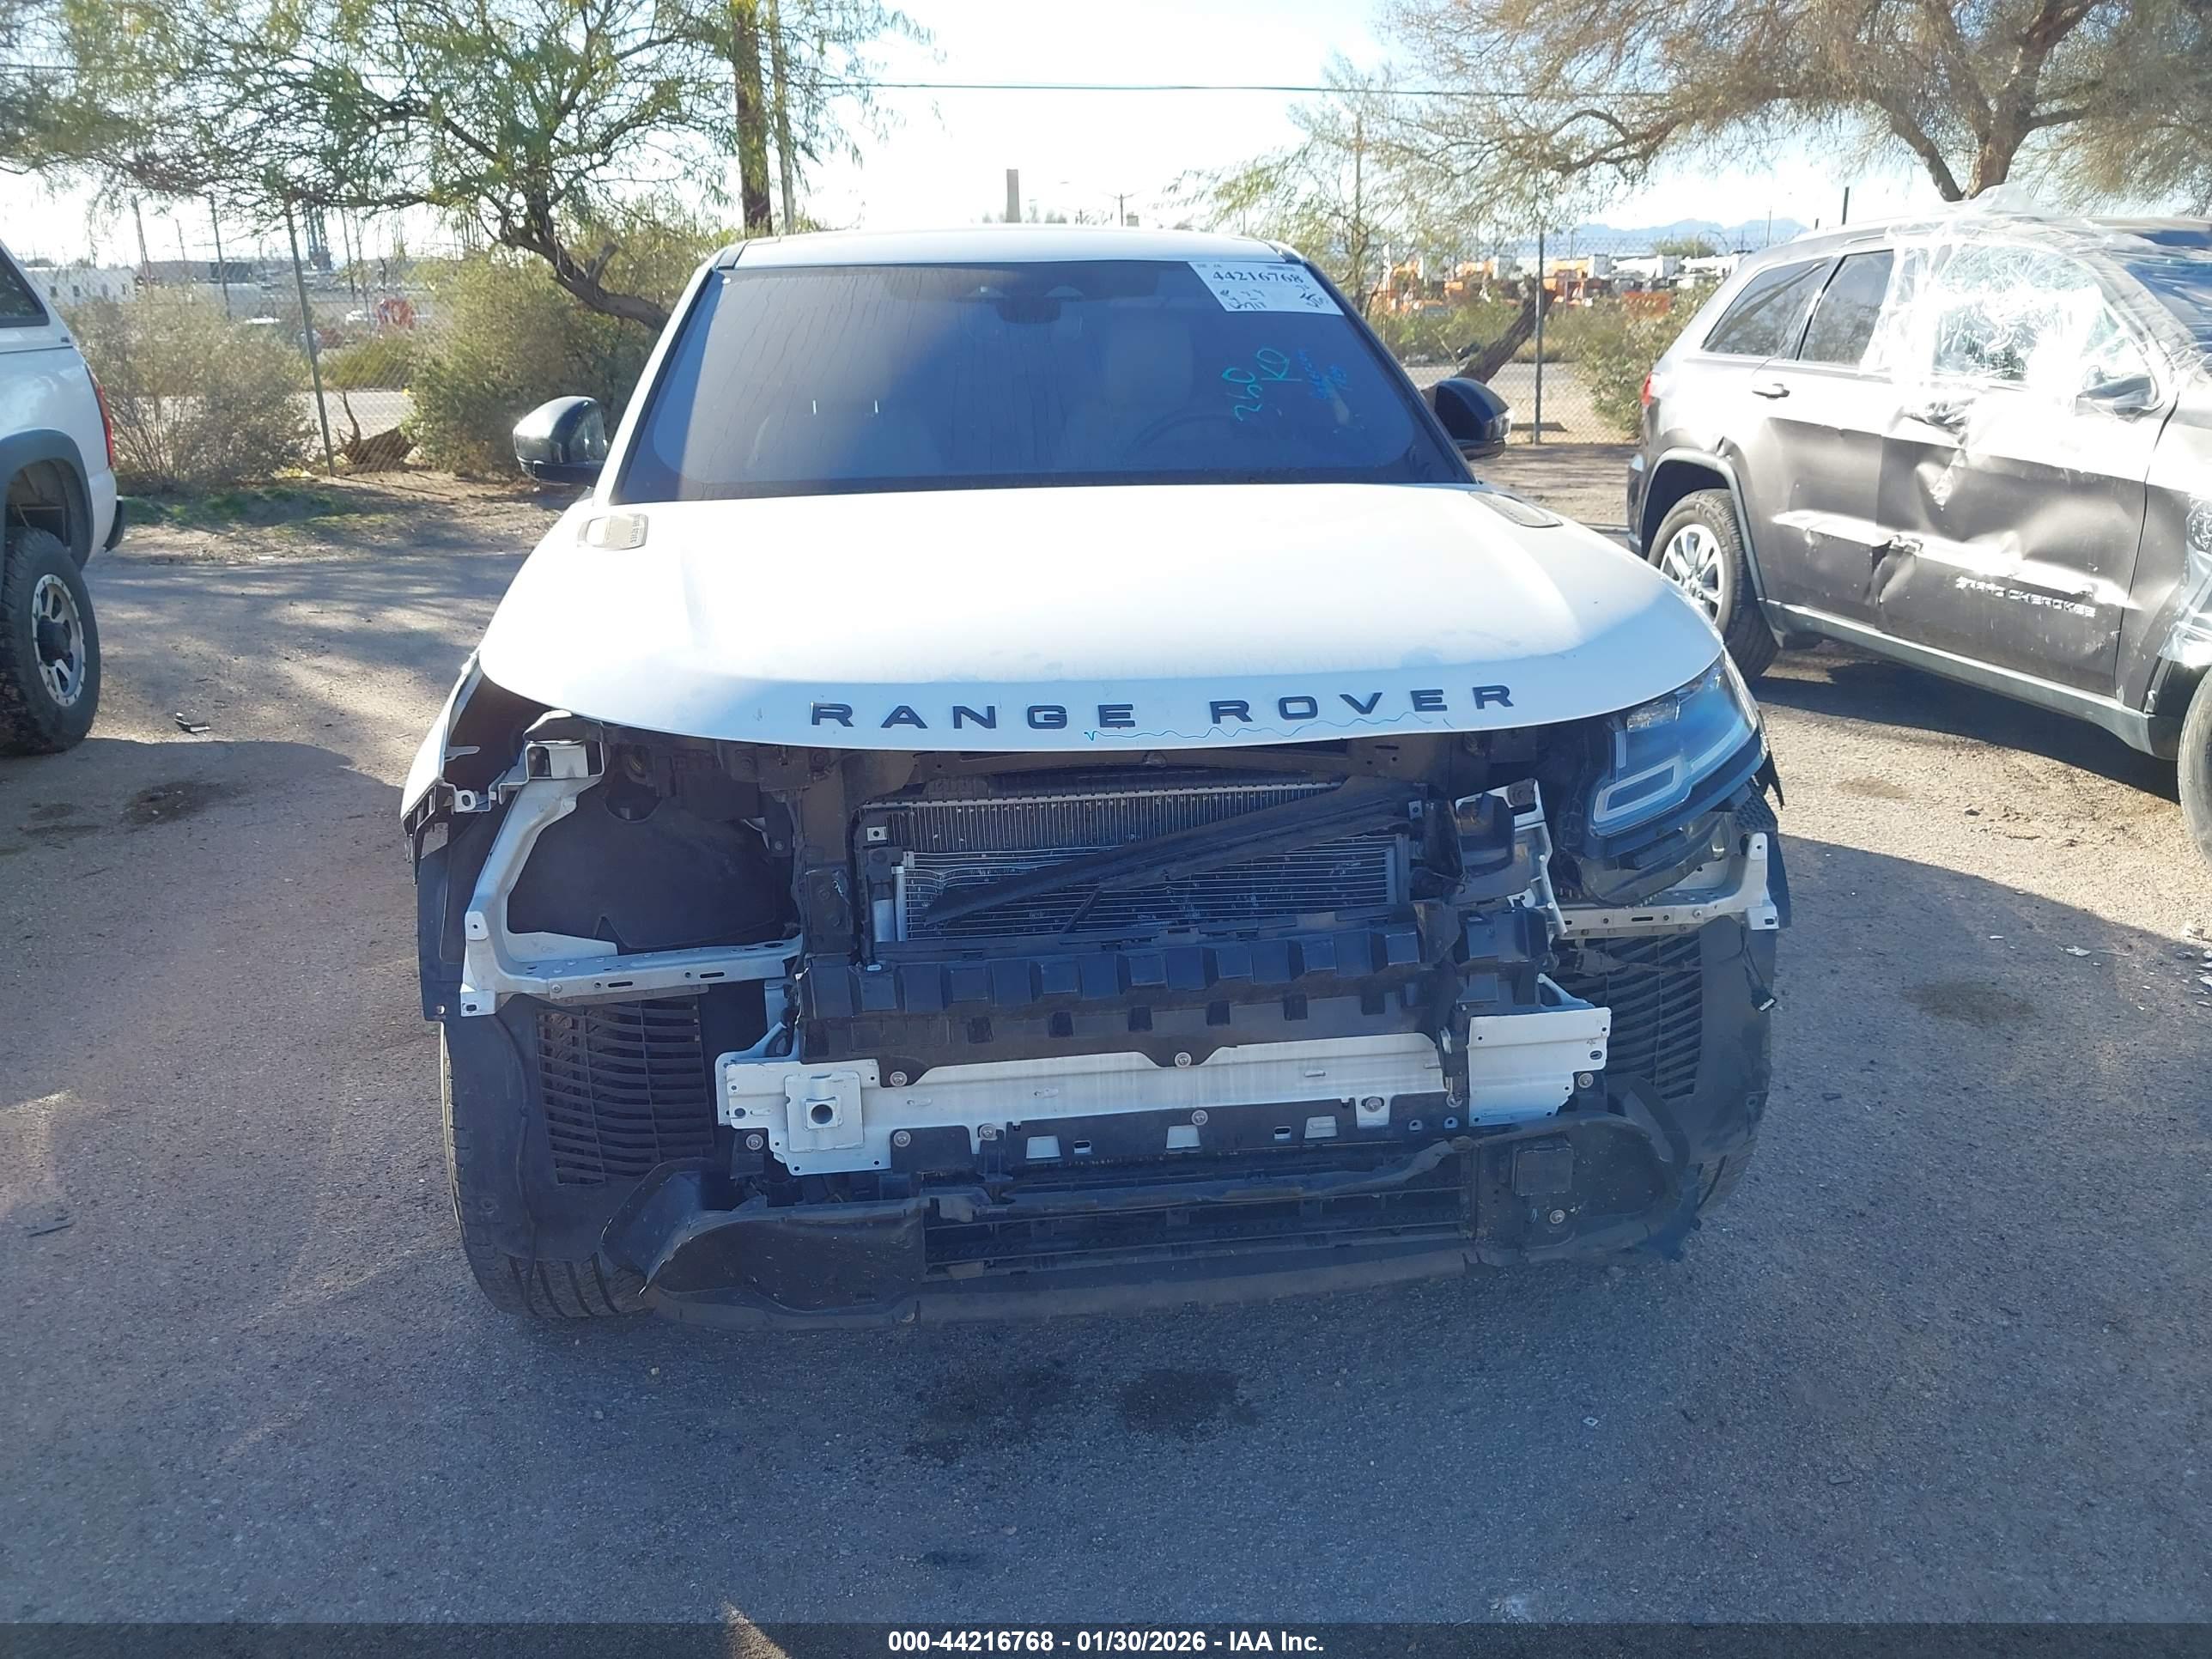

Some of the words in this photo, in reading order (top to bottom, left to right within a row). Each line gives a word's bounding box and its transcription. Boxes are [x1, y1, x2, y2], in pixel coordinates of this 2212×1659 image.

[1212, 270, 1304, 284] 44216768
[2008, 589, 2096, 618] CHEROKEE
[811, 702, 1136, 730] RANGE
[1208, 684, 1515, 726] ROVER
